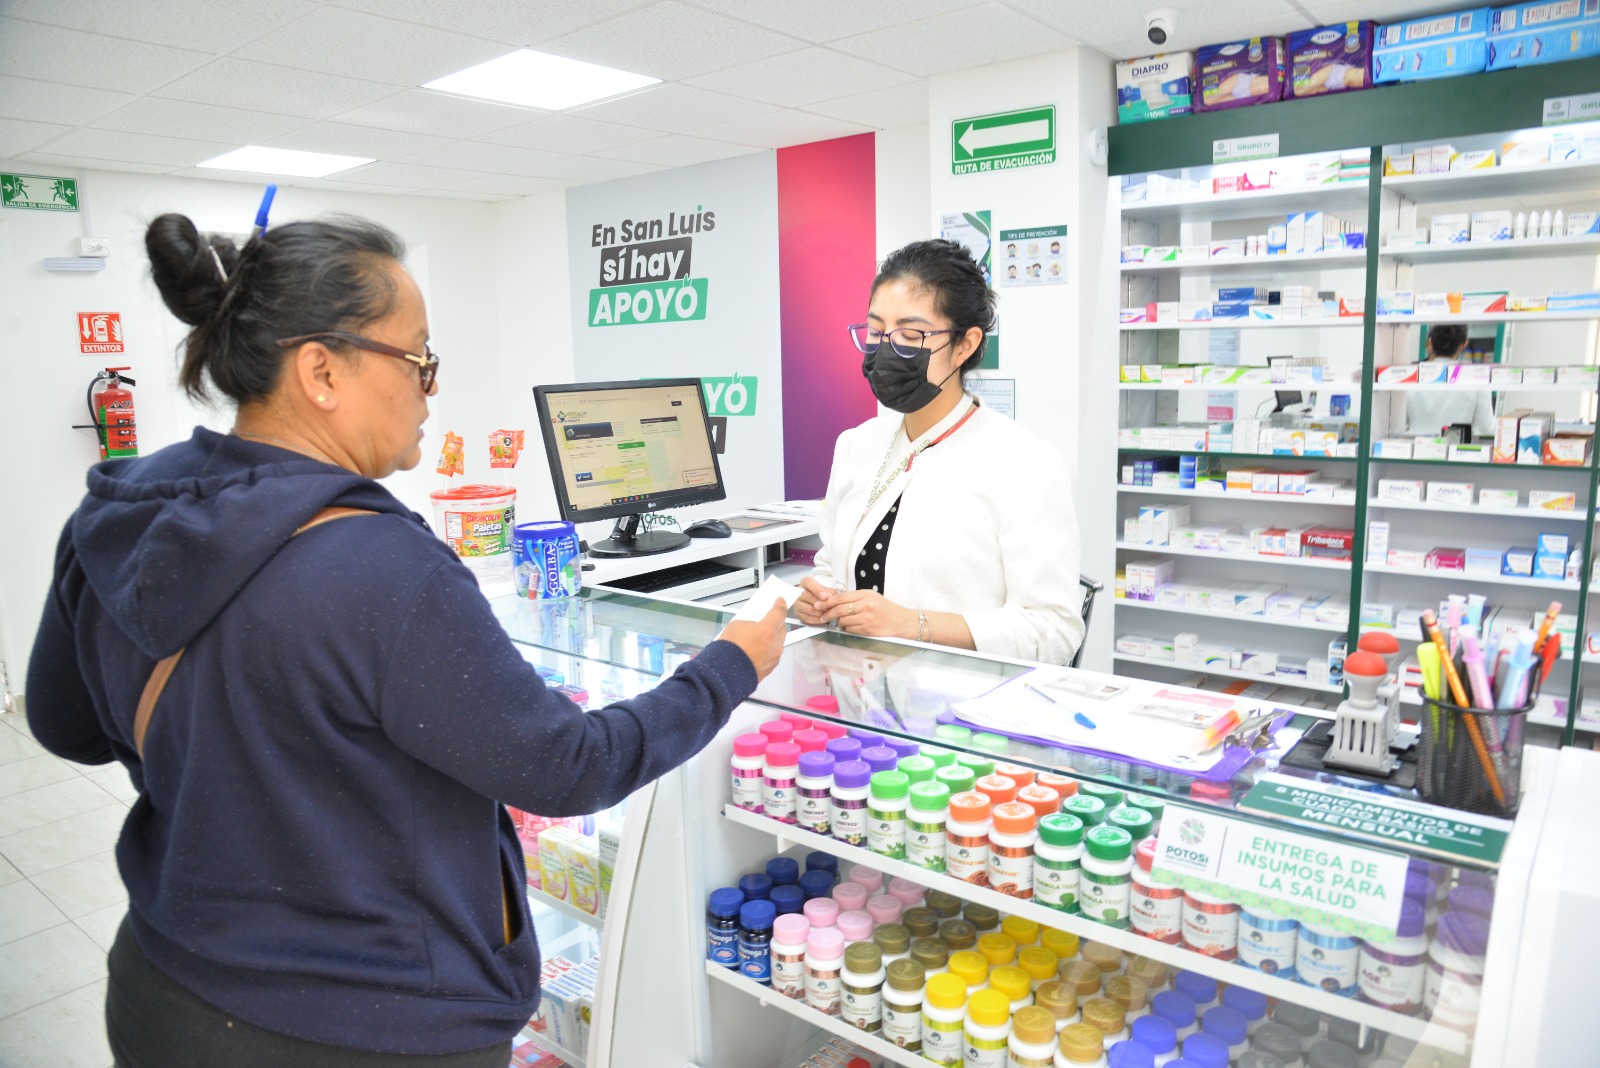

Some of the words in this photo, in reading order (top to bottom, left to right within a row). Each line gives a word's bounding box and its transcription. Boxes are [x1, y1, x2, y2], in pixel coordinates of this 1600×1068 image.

[1131, 62, 1169, 77] DIAPRO
[1238, 142, 1263, 151] GRUPO
[955, 162, 978, 175] RUTA
[980, 161, 992, 171] DE
[994, 152, 1053, 170] EVACUACIÓN
[592, 223, 616, 248] En
[620, 218, 663, 243] San
[668, 204, 716, 237] Luis
[1007, 232, 1018, 240] TIPS
[1026, 229, 1058, 239] PREVENCIÓN
[603, 247, 627, 282] sí
[630, 248, 685, 281] hay
[83, 344, 122, 353] EXTINTOR
[885, 467, 903, 485] ROSA
[466, 513, 501, 524] BRONCOLIN
[473, 522, 503, 532] Paletas
[547, 547, 559, 590] GOLBA
[1291, 788, 1449, 828] MEDICAMENTOS
[1454, 824, 1483, 837] DE
[1292, 797, 1372, 821] CUADRO
[1301, 808, 1429, 845] MENSUAL
[1251, 836, 1344, 872] ENTREGA
[1350, 860, 1379, 879] DE
[1237, 850, 1325, 885] INSUMOS
[1332, 873, 1387, 900] PARA
[1258, 873, 1283, 892] LA
[1288, 880, 1356, 910] SALUD
